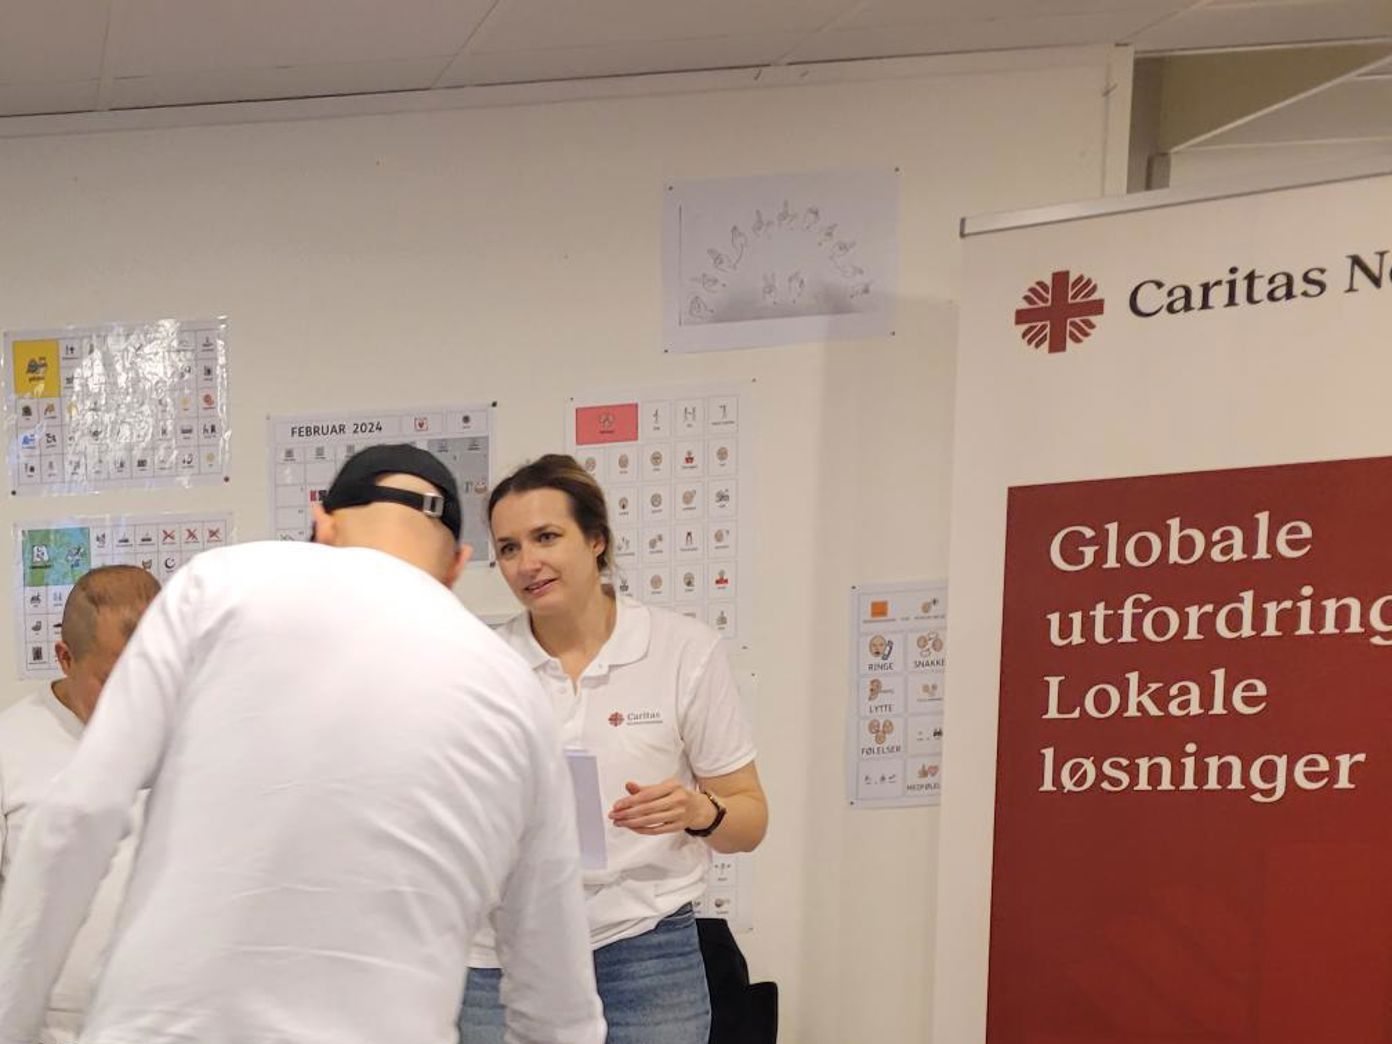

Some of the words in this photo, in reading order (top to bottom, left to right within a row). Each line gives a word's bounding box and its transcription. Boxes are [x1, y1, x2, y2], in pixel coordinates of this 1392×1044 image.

[1129, 266, 1327, 318] Caritas
[1343, 250, 1392, 293] N
[291, 424, 346, 438] FEBRUAR
[353, 421, 382, 434] 2024
[1049, 510, 1313, 572] Globale
[1046, 585, 1392, 647] utfordring
[869, 704, 893, 713] LYTTE
[1042, 668, 1268, 720] Lokale
[1038, 742, 1367, 803] løsninger
